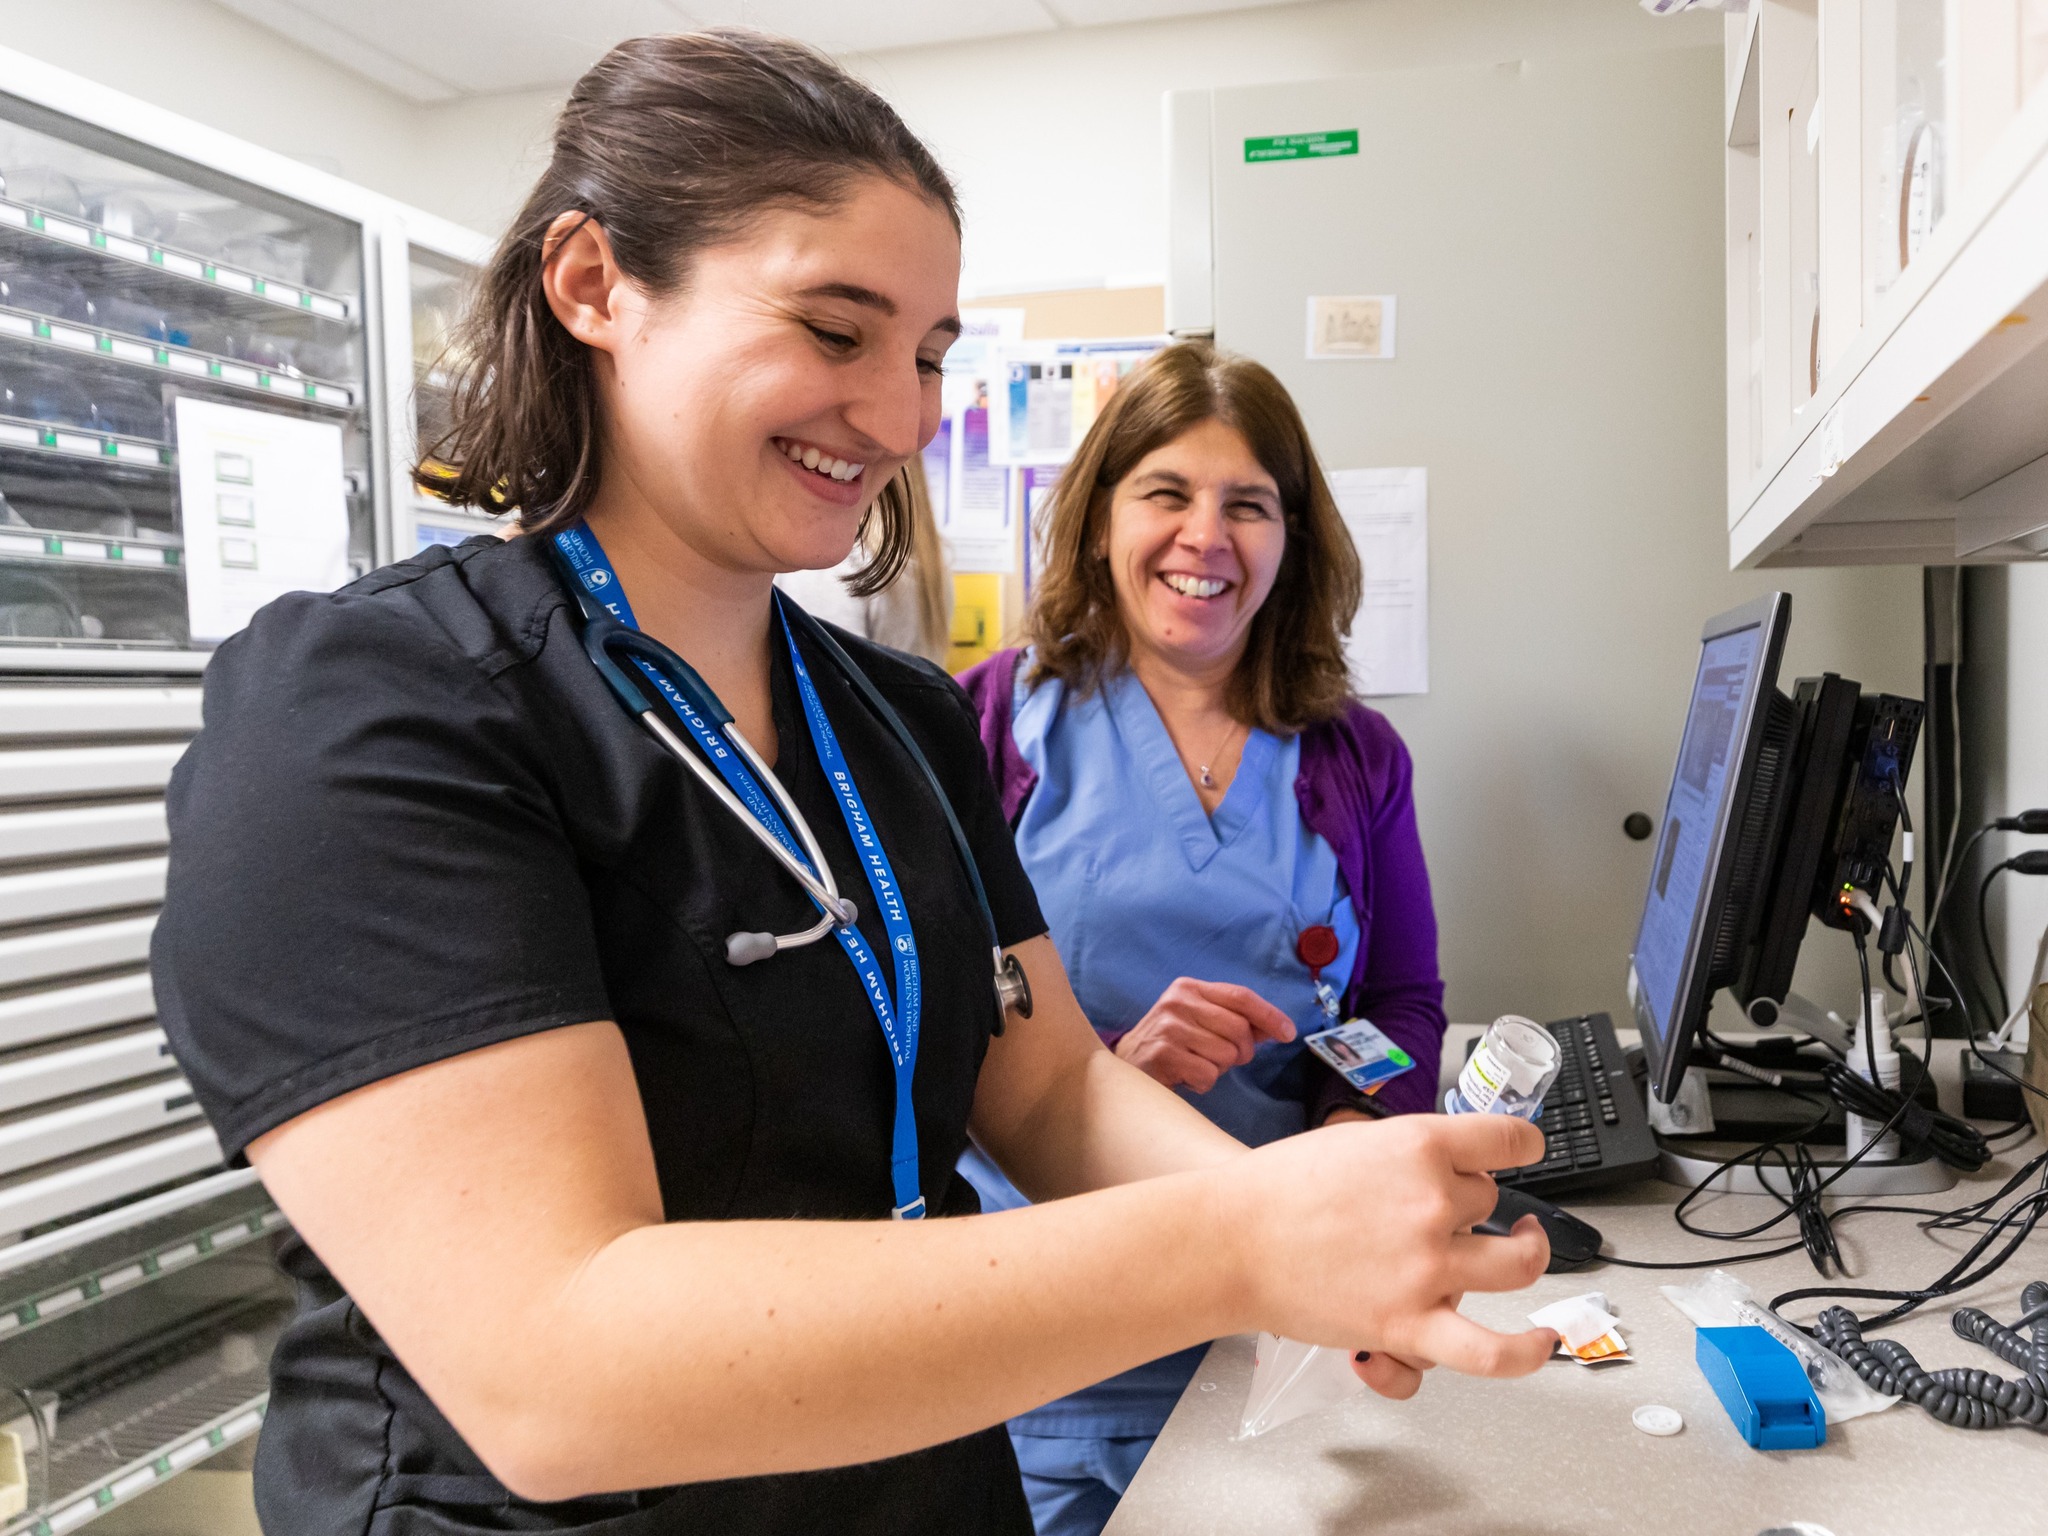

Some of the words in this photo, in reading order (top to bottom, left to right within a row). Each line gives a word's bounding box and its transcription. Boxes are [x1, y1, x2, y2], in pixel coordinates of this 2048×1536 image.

[570, 529, 594, 566] WOMEN
[658, 678, 729, 759] BRIGHAM
[833, 771, 874, 848] BRIGHAM
[868, 854, 904, 922] HEALTH
[840, 927, 868, 964] HEA
[903, 959, 913, 1010] WOMEN'S
[909, 959, 919, 1007] BRIGHAM
[866, 970, 904, 1067] BRIGHAM
[904, 1010, 913, 1063] HOSPITAL
[911, 1008, 919, 1032] AND
